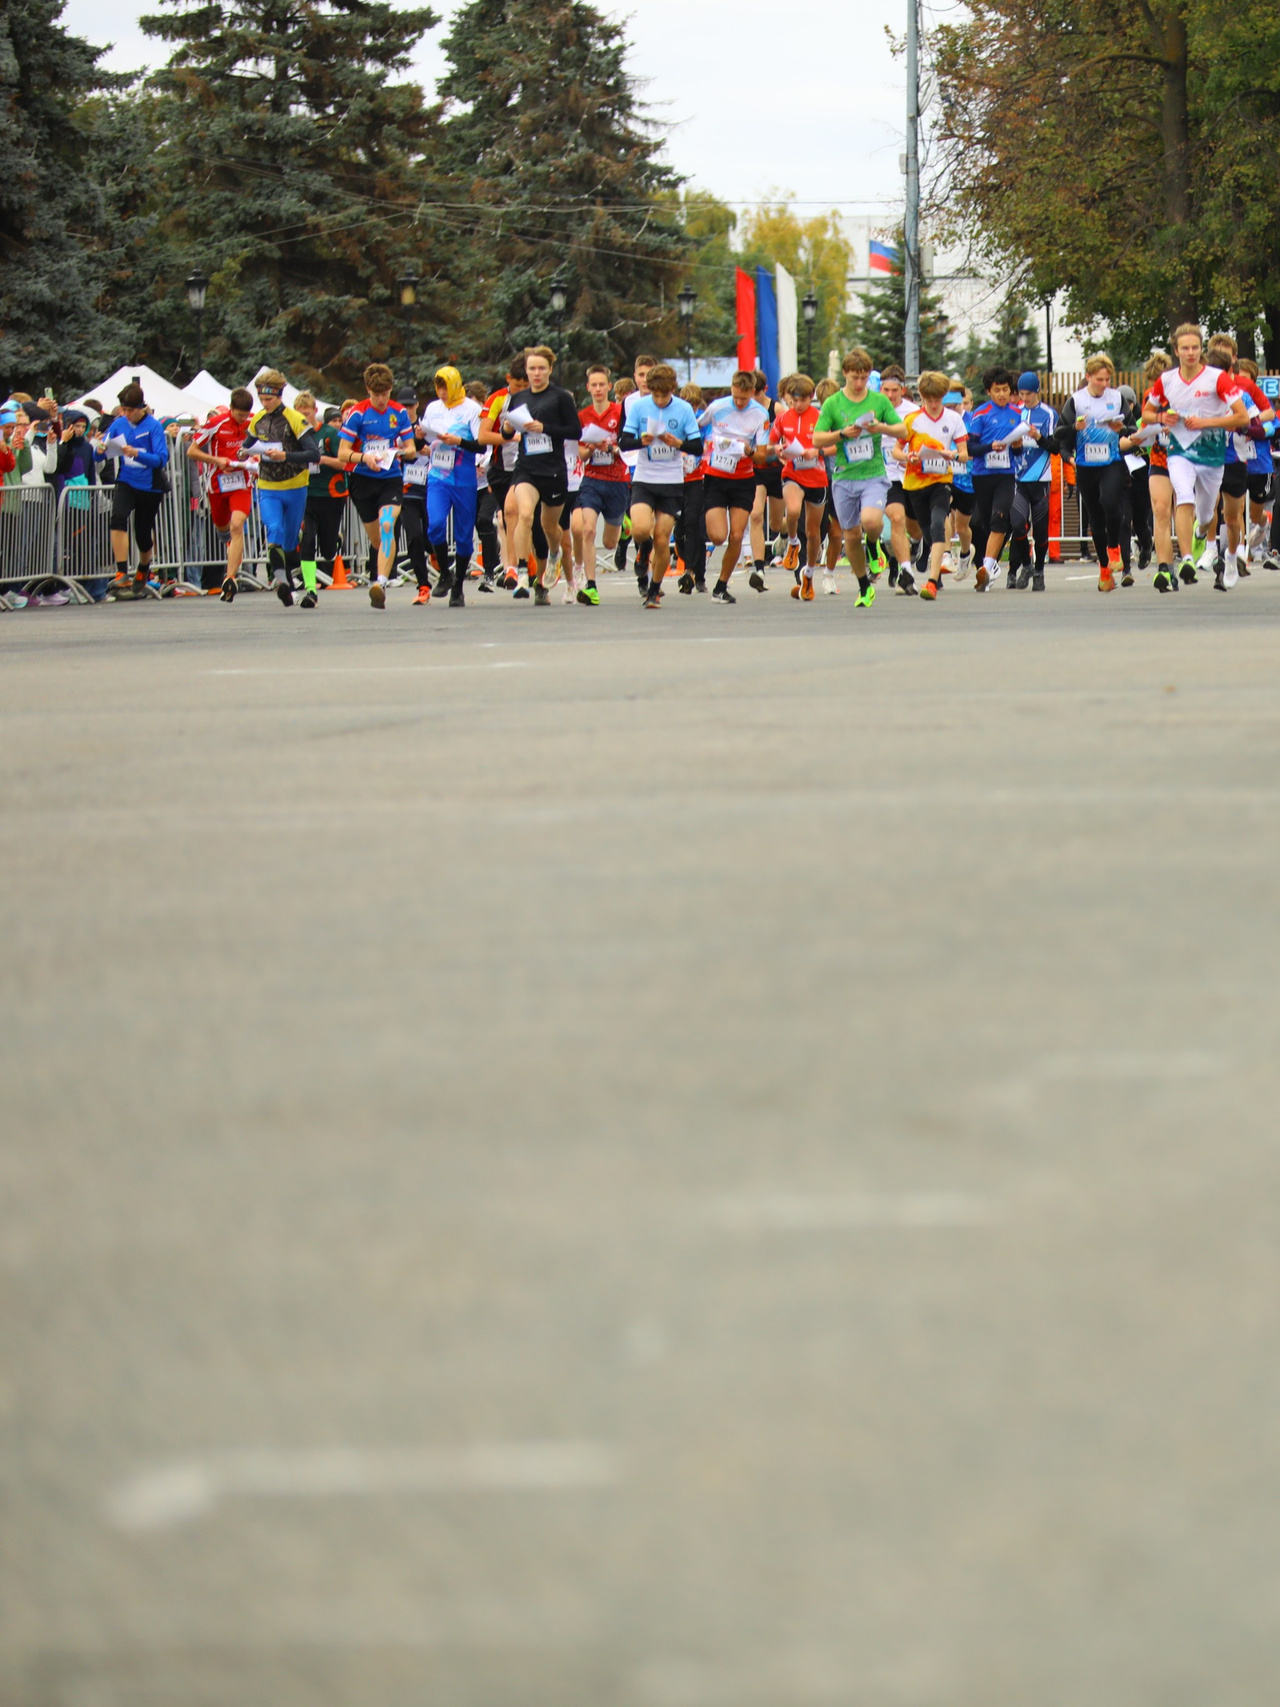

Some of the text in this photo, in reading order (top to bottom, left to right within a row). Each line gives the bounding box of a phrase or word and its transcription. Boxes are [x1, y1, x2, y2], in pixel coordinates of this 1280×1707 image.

[528, 436, 547, 446] 308.1
[653, 446, 672, 455] 310.1
[848, 443, 869, 455] 312.1
[1089, 446, 1107, 455] 333.1
[434, 452, 450, 462] 304.1
[715, 455, 733, 466] 327.1
[926, 459, 945, 468] 311.1
